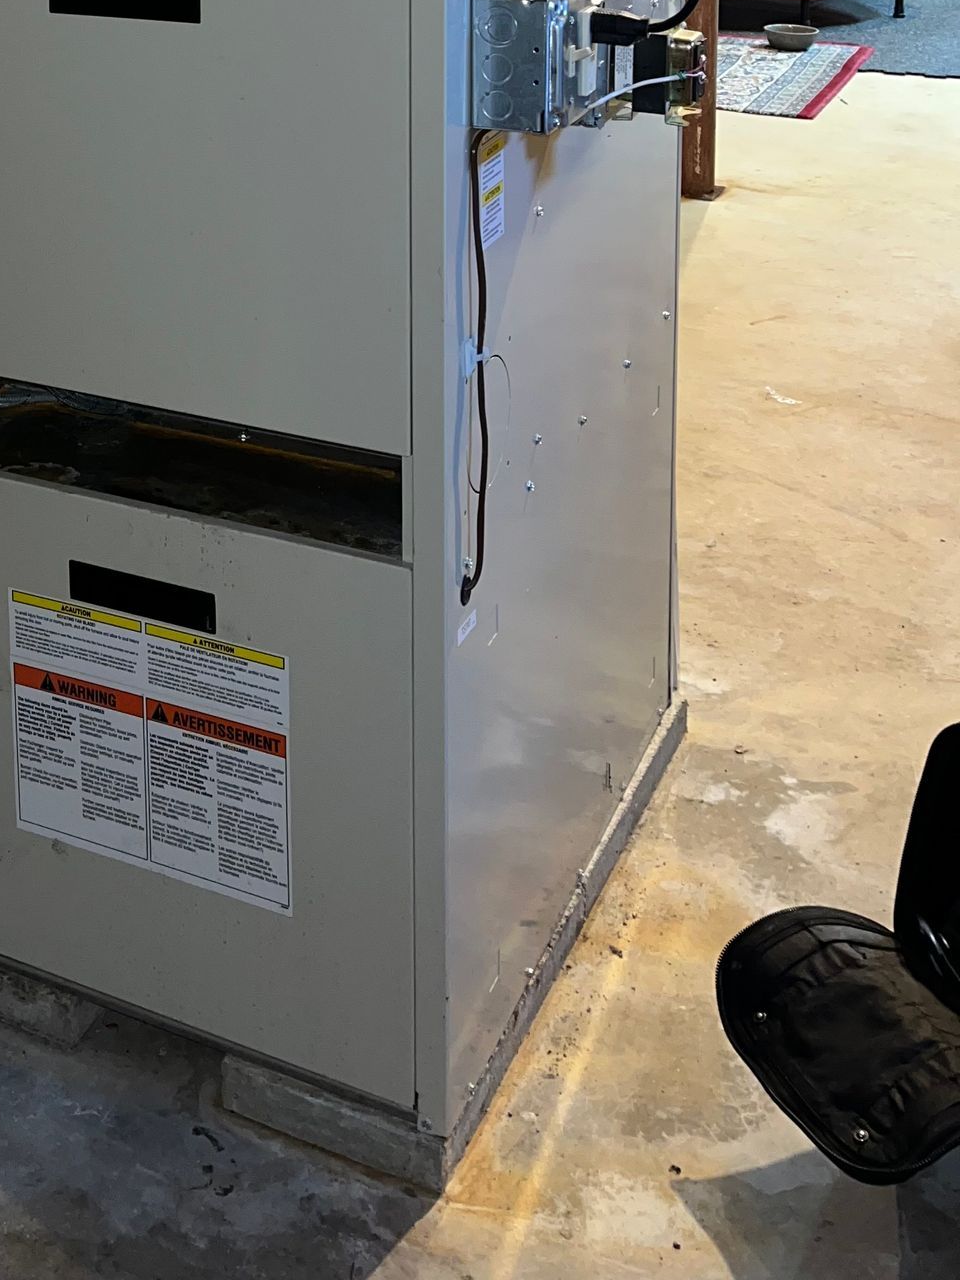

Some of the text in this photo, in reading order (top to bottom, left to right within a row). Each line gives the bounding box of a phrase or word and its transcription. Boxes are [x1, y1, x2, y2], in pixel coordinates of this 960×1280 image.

[64, 605, 91, 617] CAUTION
[199, 639, 234, 654] ATTENTION
[58, 679, 116, 708] WARNING
[172, 710, 280, 754] AVERTISSEMENT
